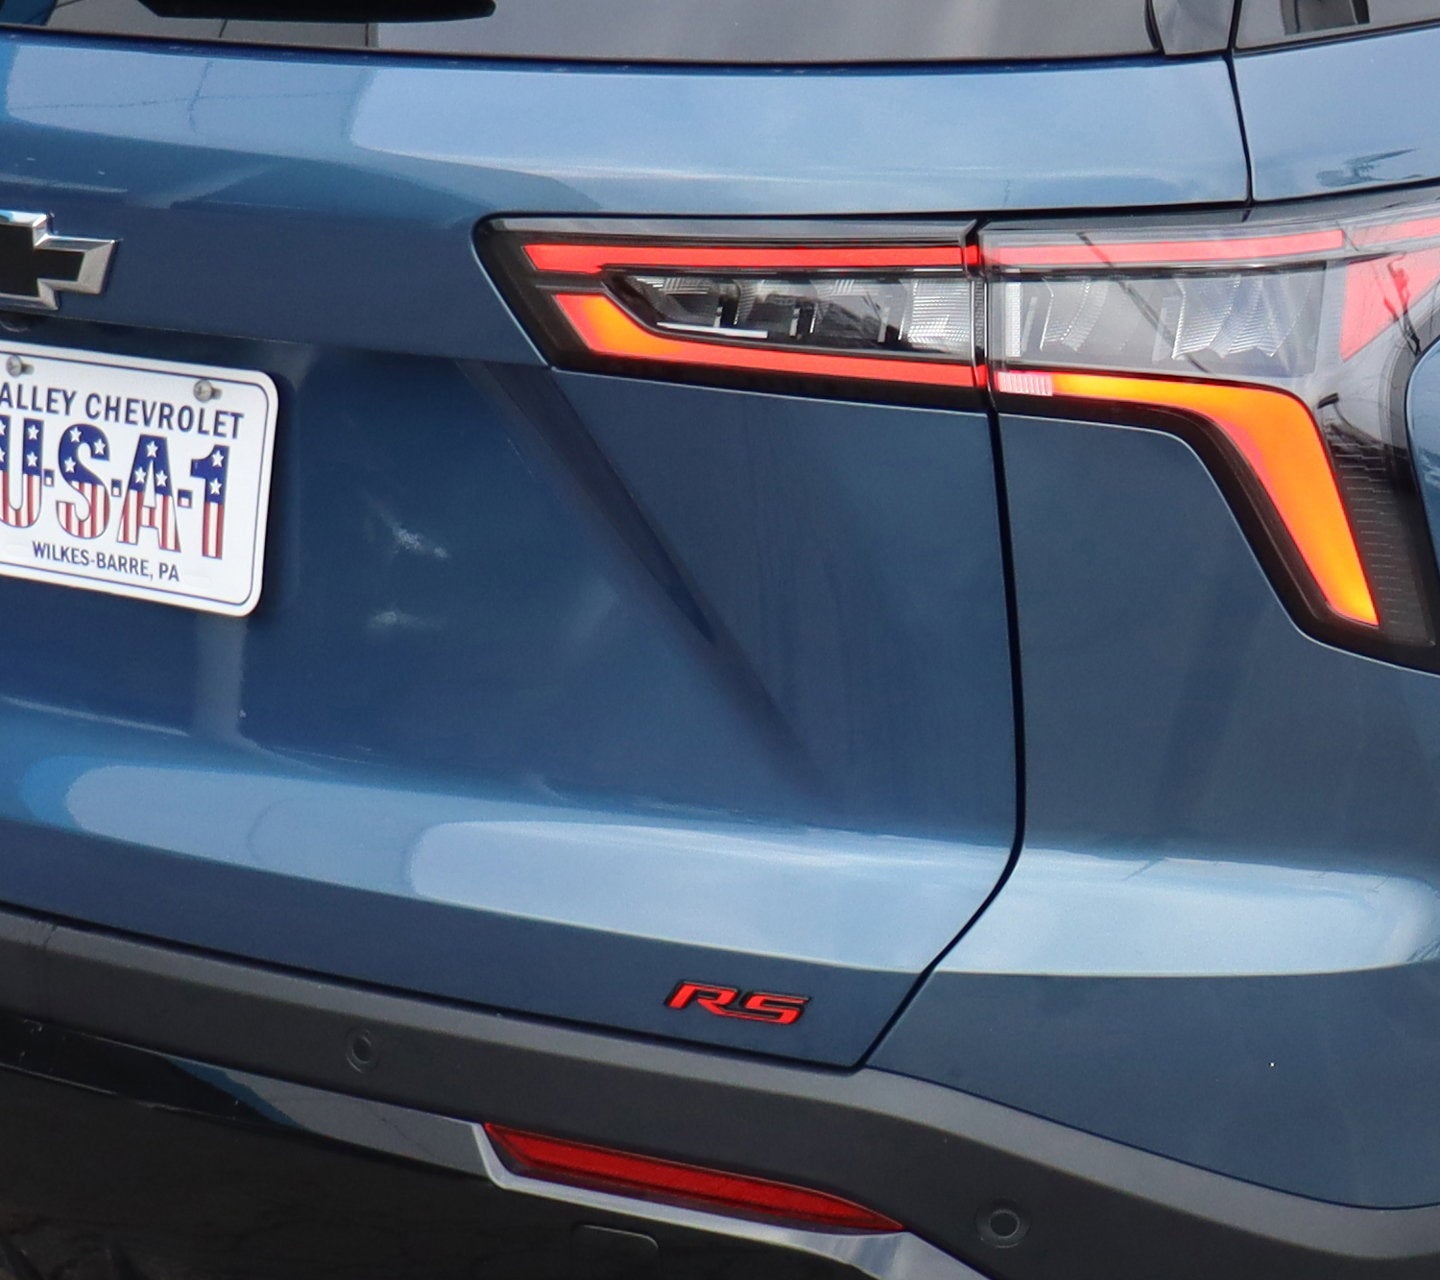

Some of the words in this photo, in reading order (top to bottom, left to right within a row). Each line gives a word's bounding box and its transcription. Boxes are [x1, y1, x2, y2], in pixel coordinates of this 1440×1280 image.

[85, 392, 245, 440] CHEVROLET
[31, 540, 155, 582] WILKES-BARRE,
[158, 561, 180, 583] PA
[665, 979, 812, 1025] RS
